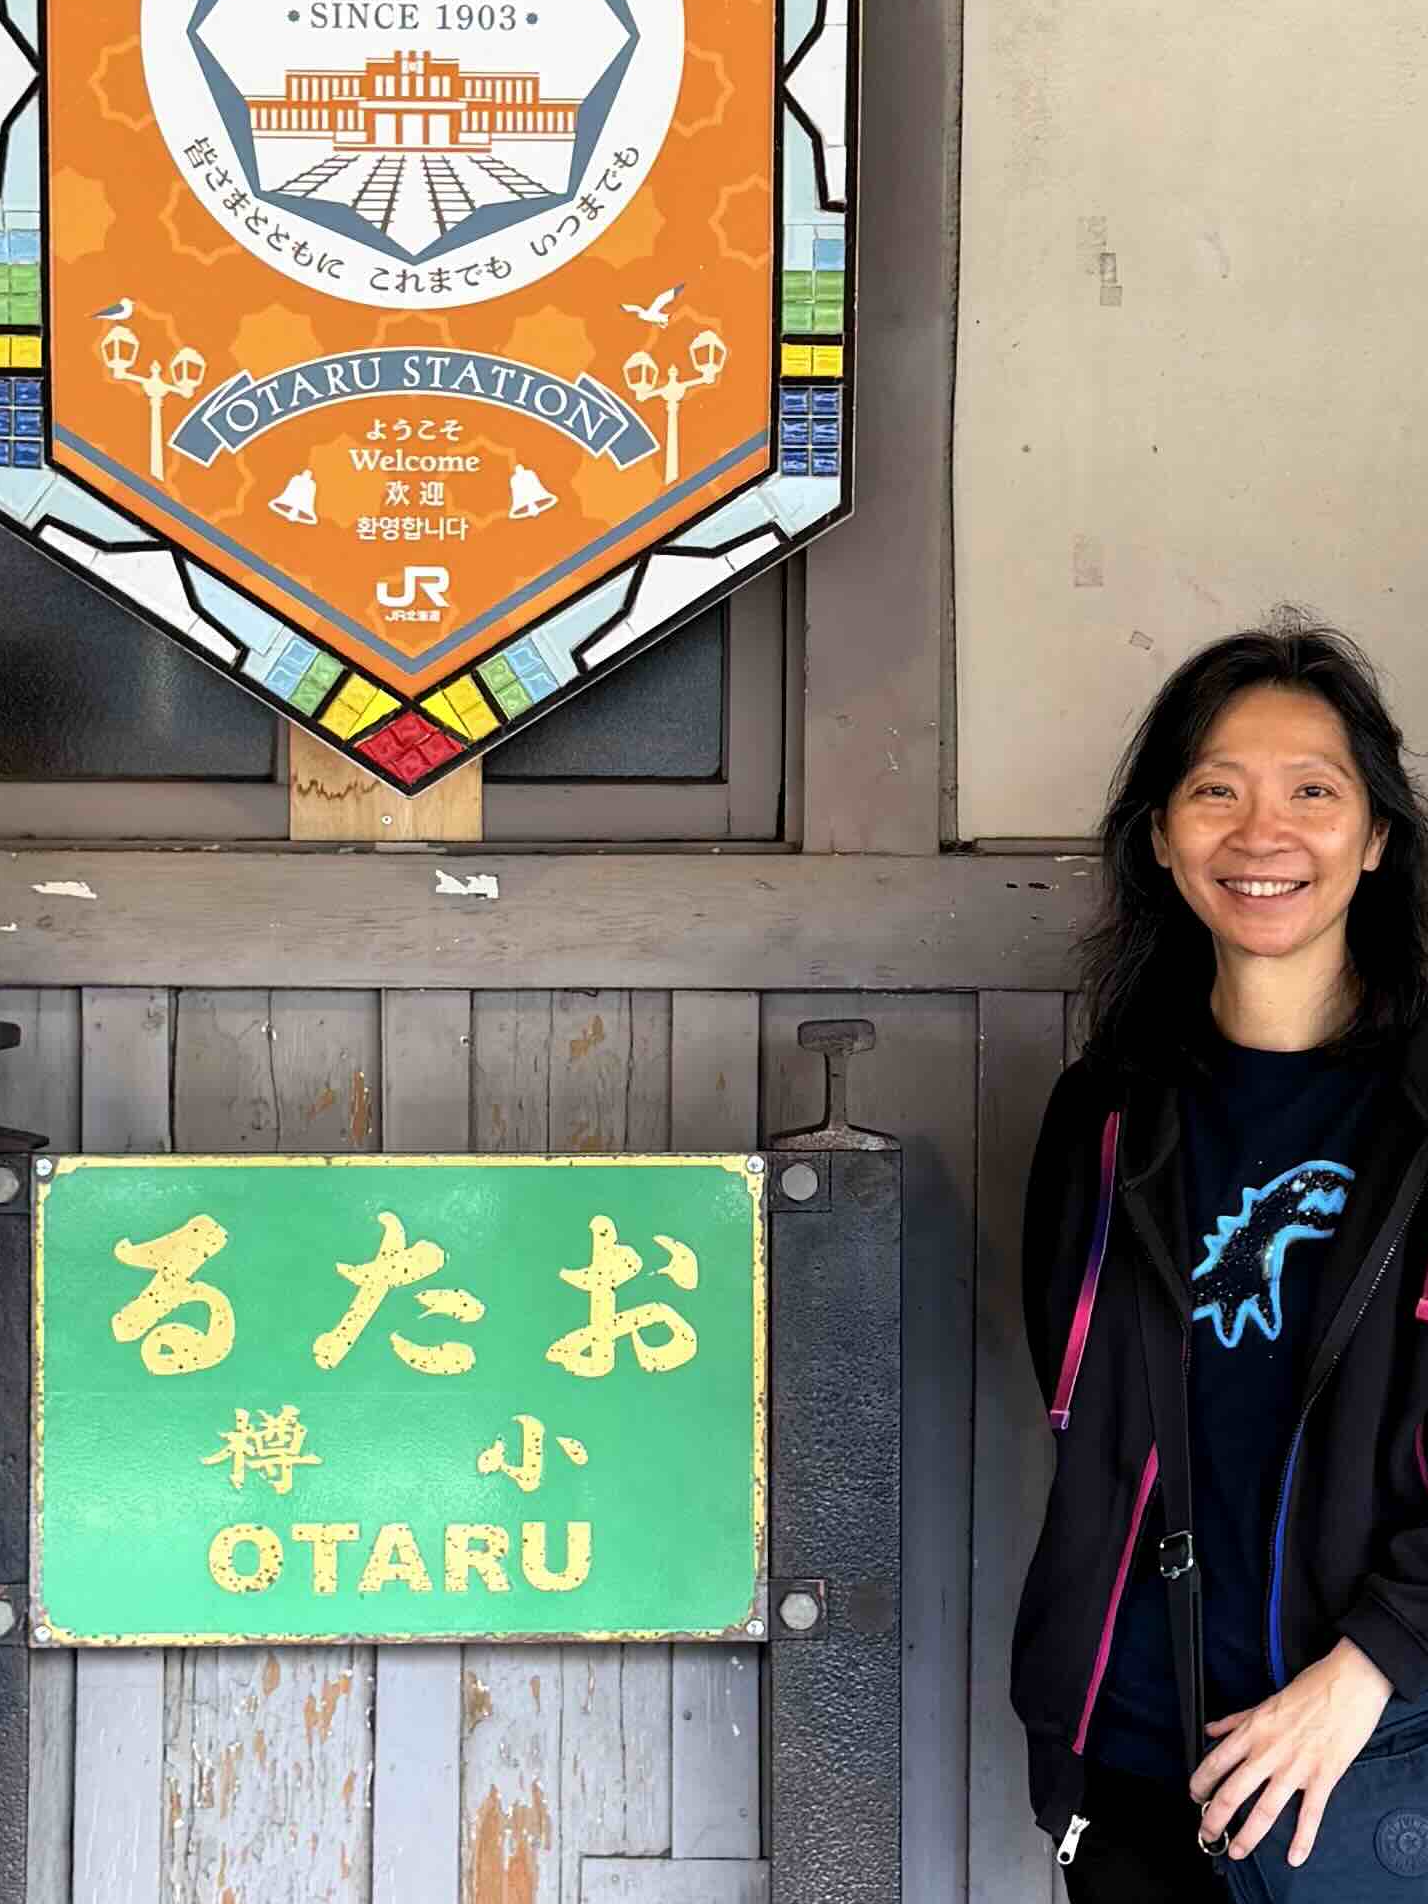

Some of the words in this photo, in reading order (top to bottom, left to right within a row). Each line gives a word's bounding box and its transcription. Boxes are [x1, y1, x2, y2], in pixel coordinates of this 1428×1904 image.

[310, 2, 420, 30] SINCE
[436, 3, 517, 31] 1903
[368, 254, 513, 294] これまでも
[529, 145, 641, 259] いつまでも
[225, 357, 382, 433] OTARU
[403, 355, 611, 441] STATION
[366, 418, 464, 441] ようこそ
[348, 448, 481, 472] Welcome
[355, 516, 470, 541] 환영합니다
[376, 565, 451, 608] JR
[208, 1521, 593, 1594] OTARU
